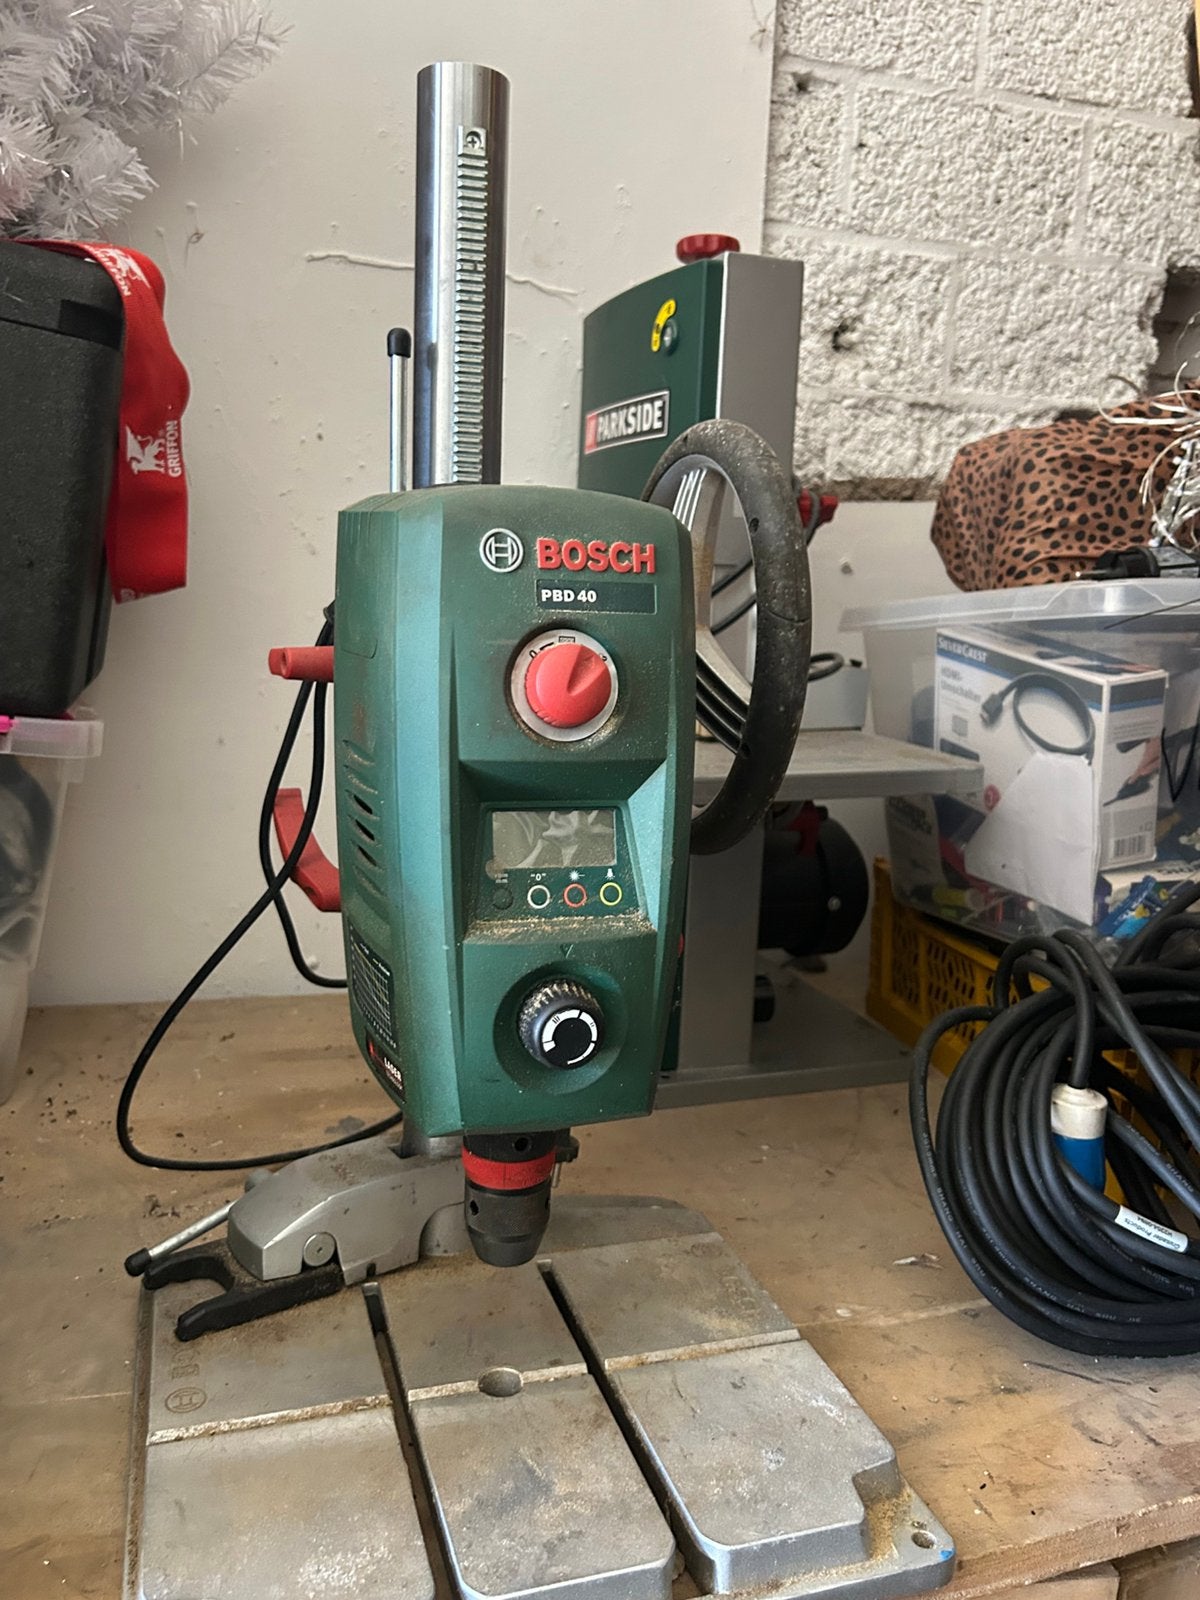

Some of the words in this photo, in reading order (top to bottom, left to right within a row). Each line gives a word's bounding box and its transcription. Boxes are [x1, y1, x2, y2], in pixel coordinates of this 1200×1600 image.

[597, 400, 663, 442] PARKSIDE
[166, 420, 180, 478] GRIFFON
[536, 537, 656, 574] BOSCH
[541, 589, 575, 602] PBD
[577, 590, 597, 603] 40
[1125, 1218, 1152, 1236] Products
